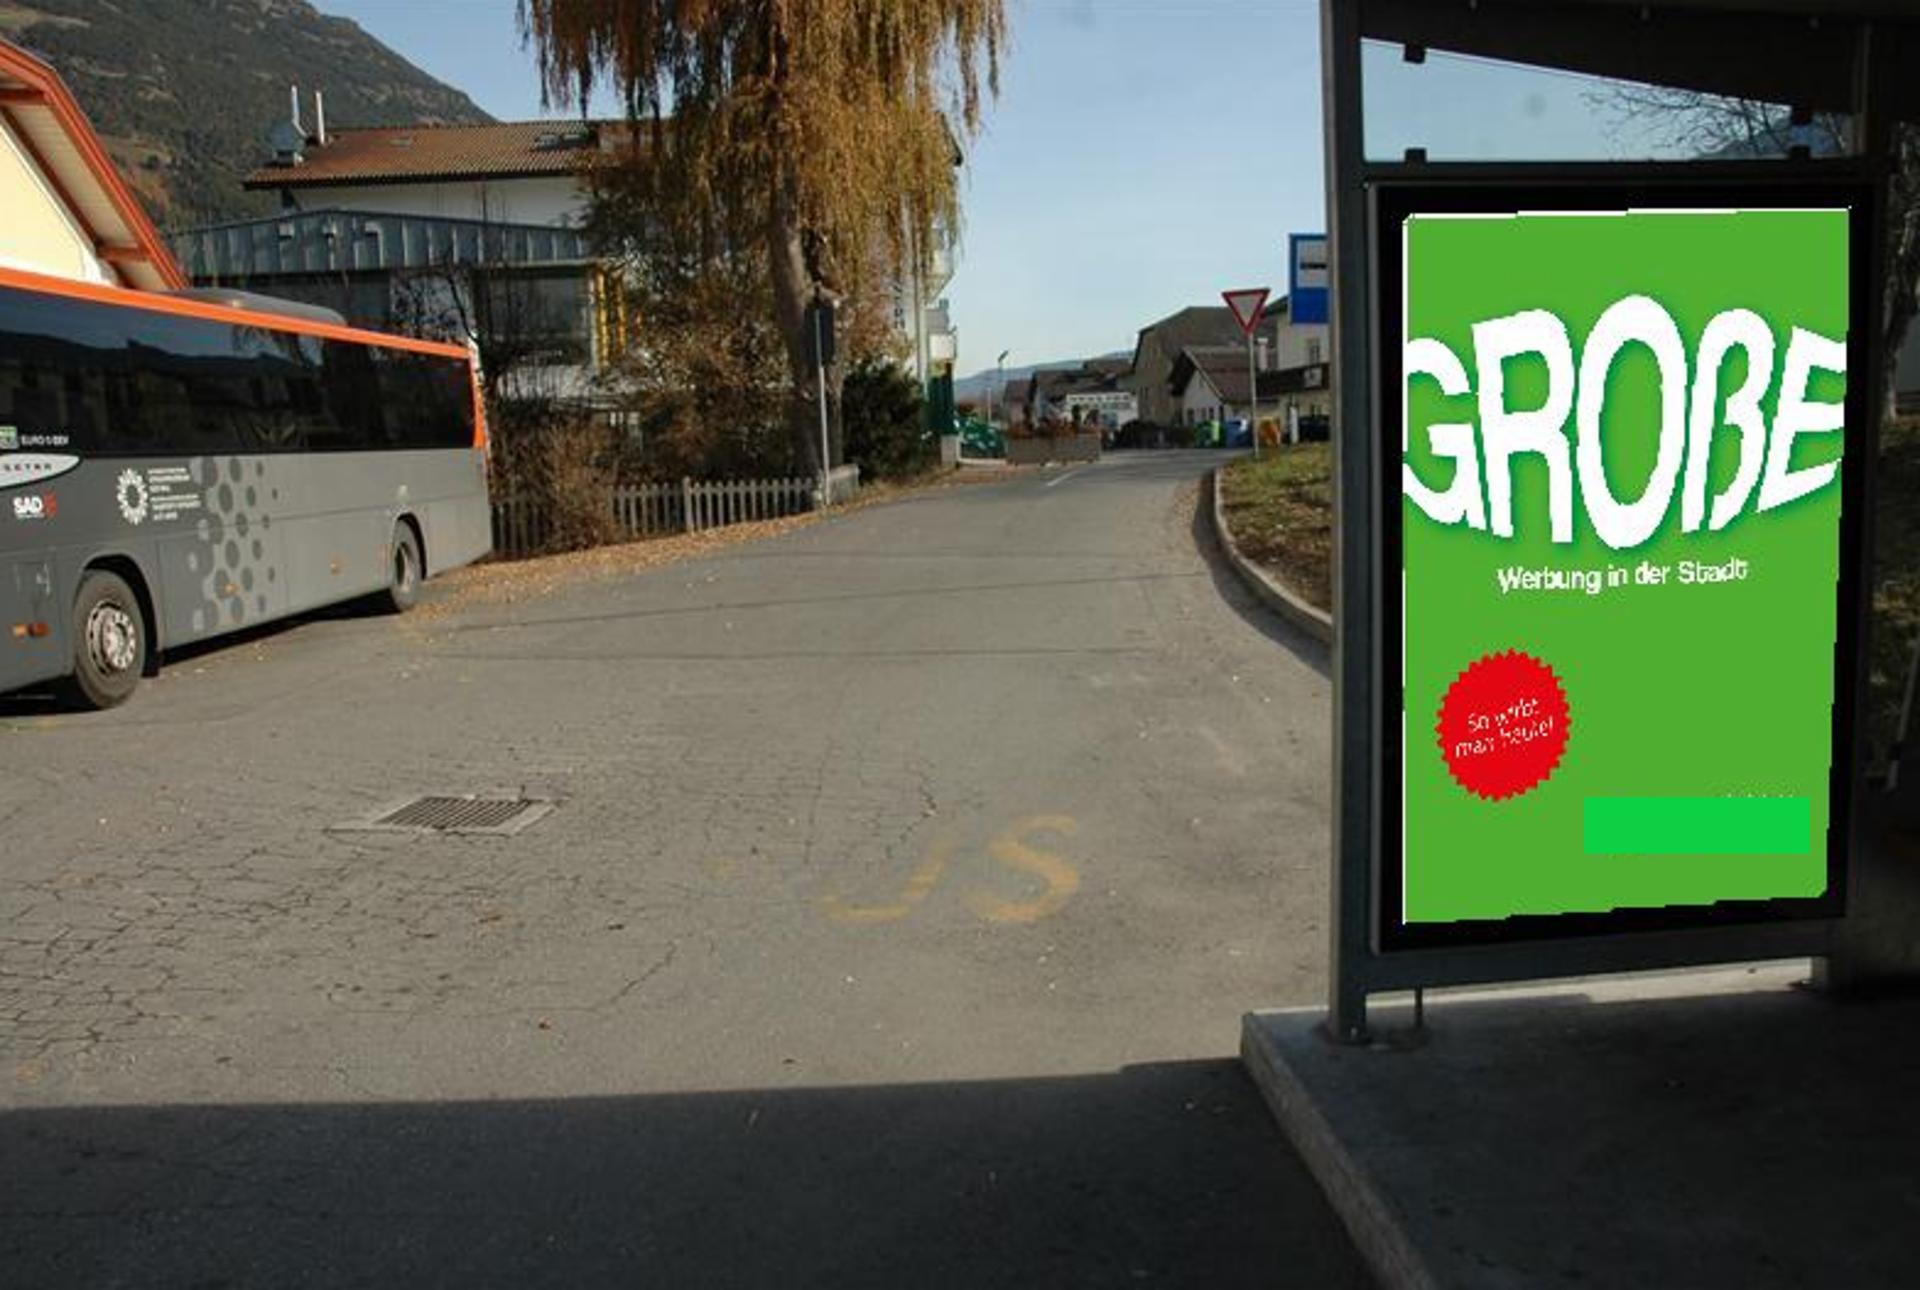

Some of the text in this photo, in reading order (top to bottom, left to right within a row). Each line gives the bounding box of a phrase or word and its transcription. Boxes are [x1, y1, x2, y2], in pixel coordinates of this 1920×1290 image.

[1498, 557, 1749, 595] Werbung in der Stadt
